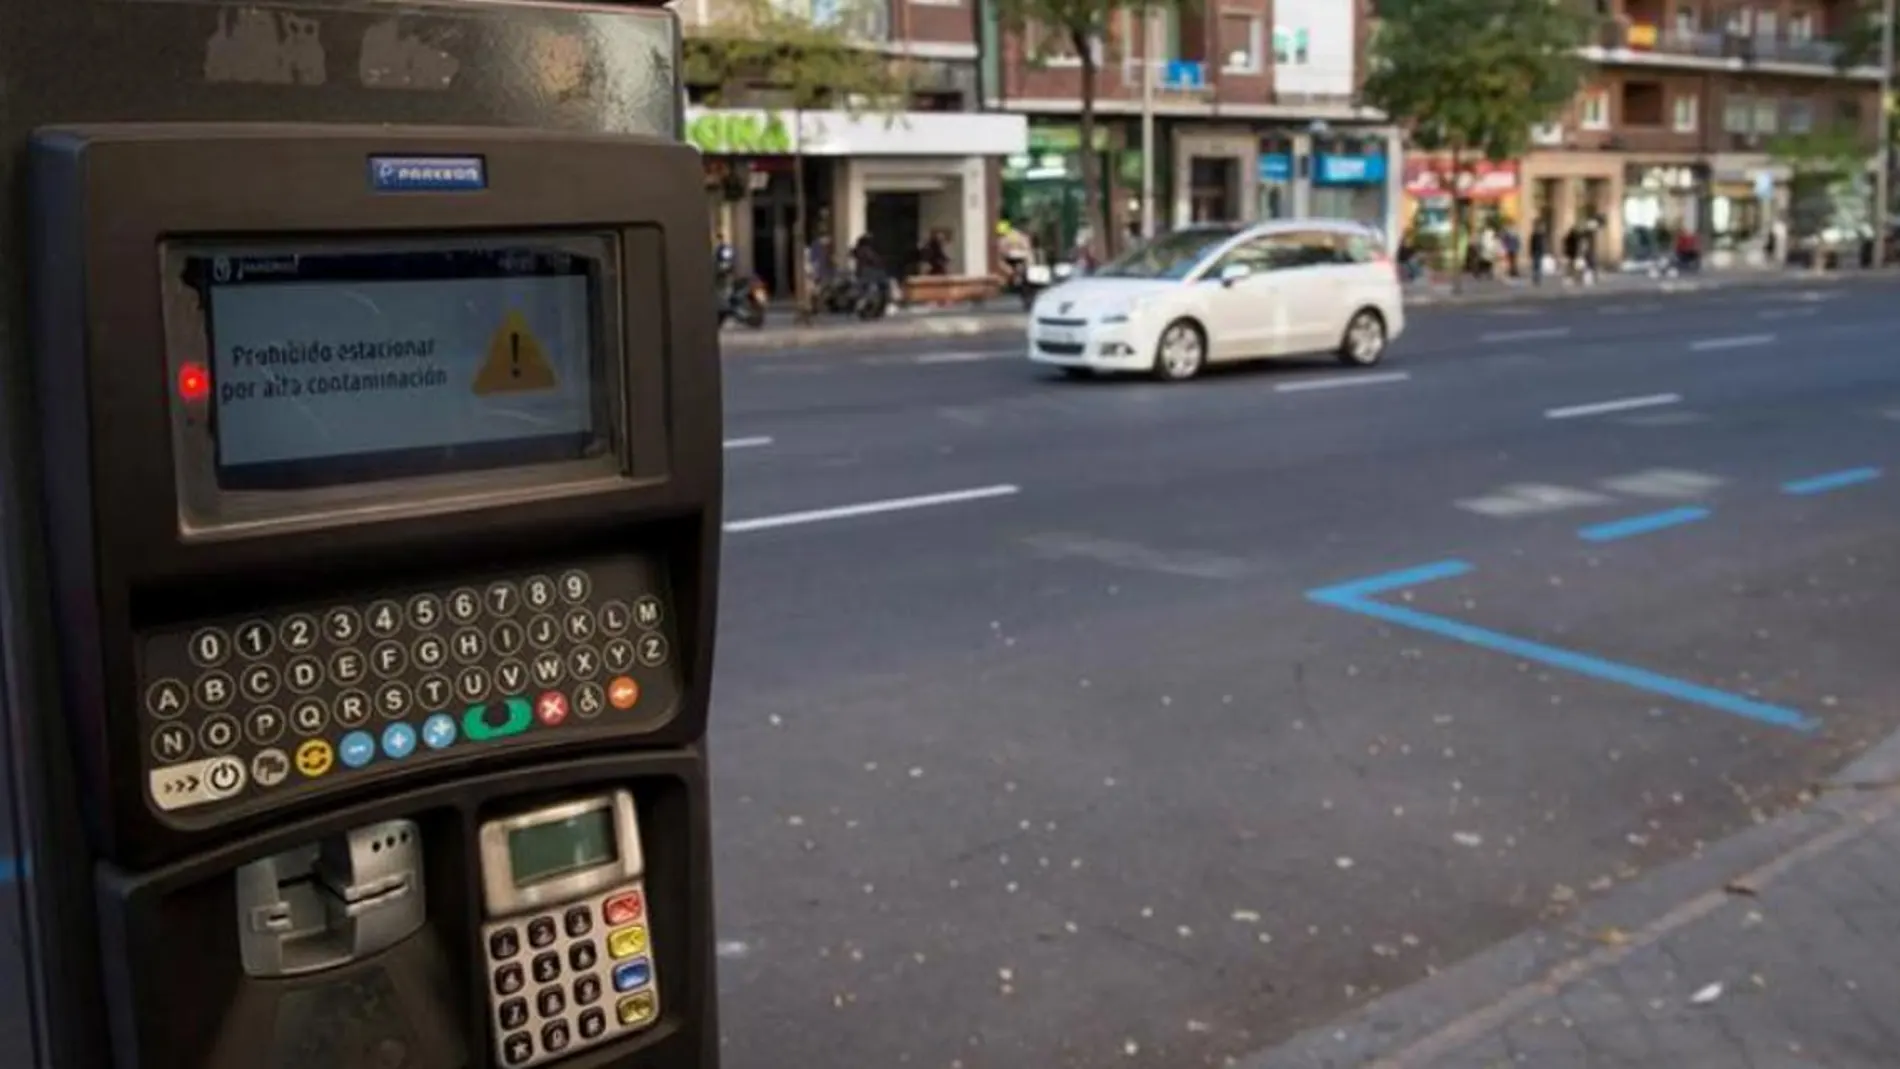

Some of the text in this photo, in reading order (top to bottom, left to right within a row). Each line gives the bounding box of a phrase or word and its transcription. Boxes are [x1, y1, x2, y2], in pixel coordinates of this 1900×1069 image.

[220, 380, 257, 404] por
[306, 363, 449, 396] contaminación
[232, 337, 436, 367] Prohibido estacionar
[158, 603, 656, 711] A B C D E F G H I J K L M
[200, 576, 582, 660] 0 1 2 3 4 5 6 7 8 9
[163, 639, 660, 753] N O P Q R S T U V W X Y Z
